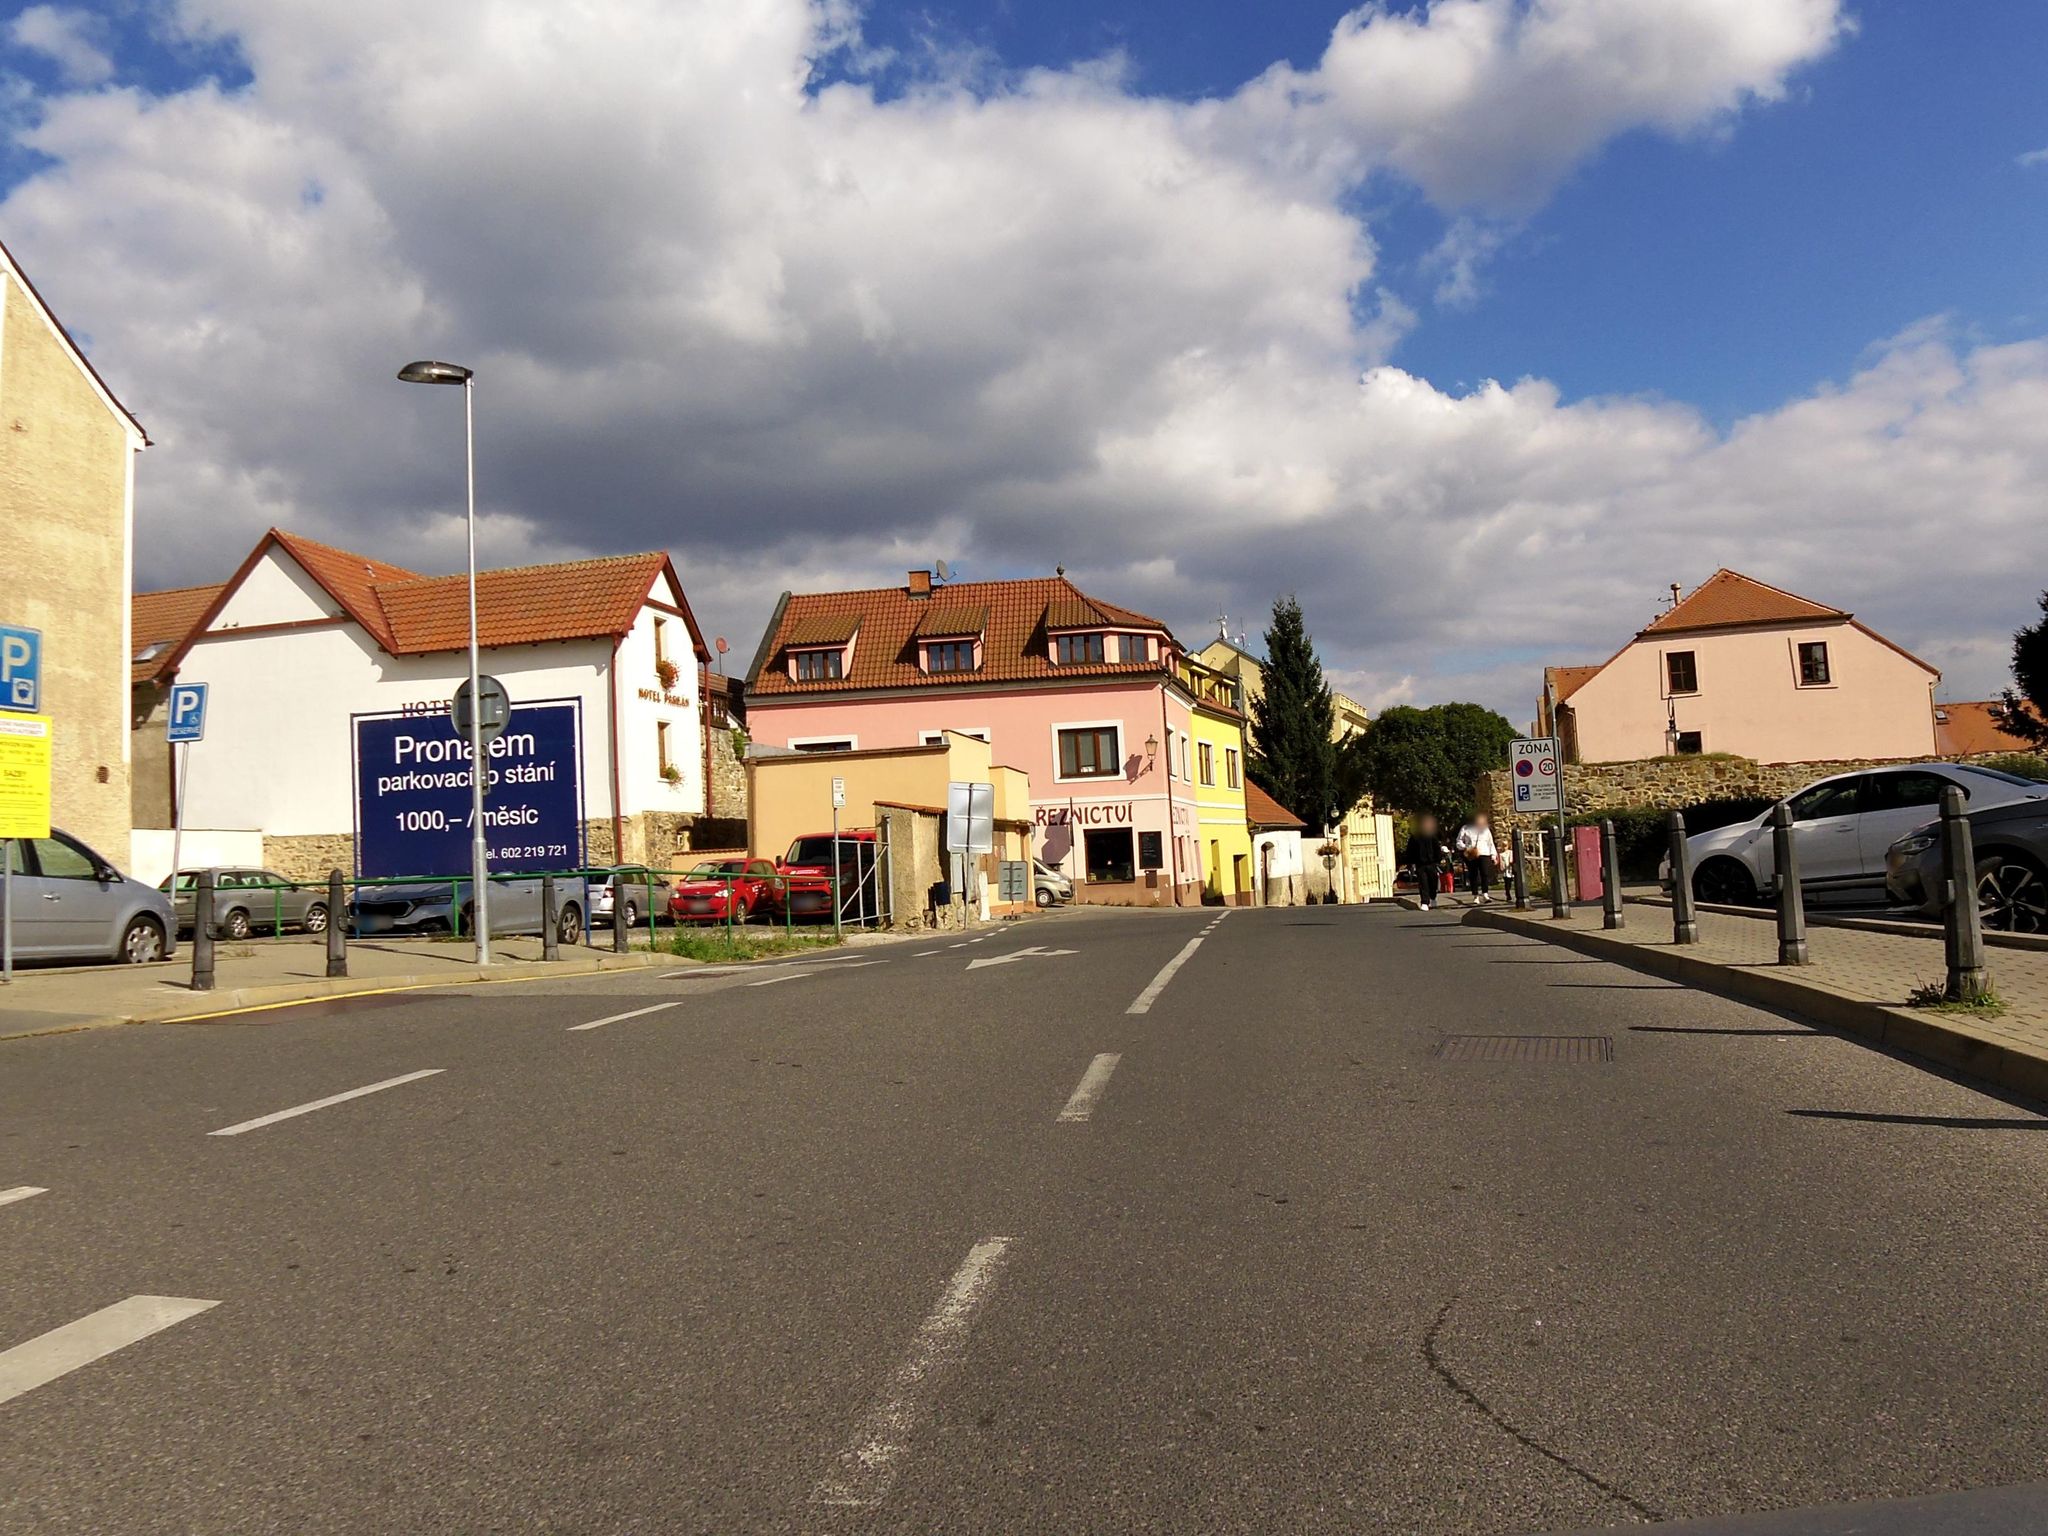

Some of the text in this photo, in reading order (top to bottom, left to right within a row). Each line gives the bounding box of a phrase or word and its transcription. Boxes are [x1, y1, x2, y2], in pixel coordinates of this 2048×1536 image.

[2, 636, 31, 683] P
[176, 691, 198, 723] P
[402, 699, 453, 718] HOTE
[395, 733, 535, 764] Pronem
[1519, 742, 1551, 754] ZÓNA
[378, 761, 555, 796] parkovacío stání
[1543, 763, 1553, 771] 20
[1035, 801, 1133, 827] ŘEZNICTVÍ
[485, 844, 568, 860] el. 602 219 721
